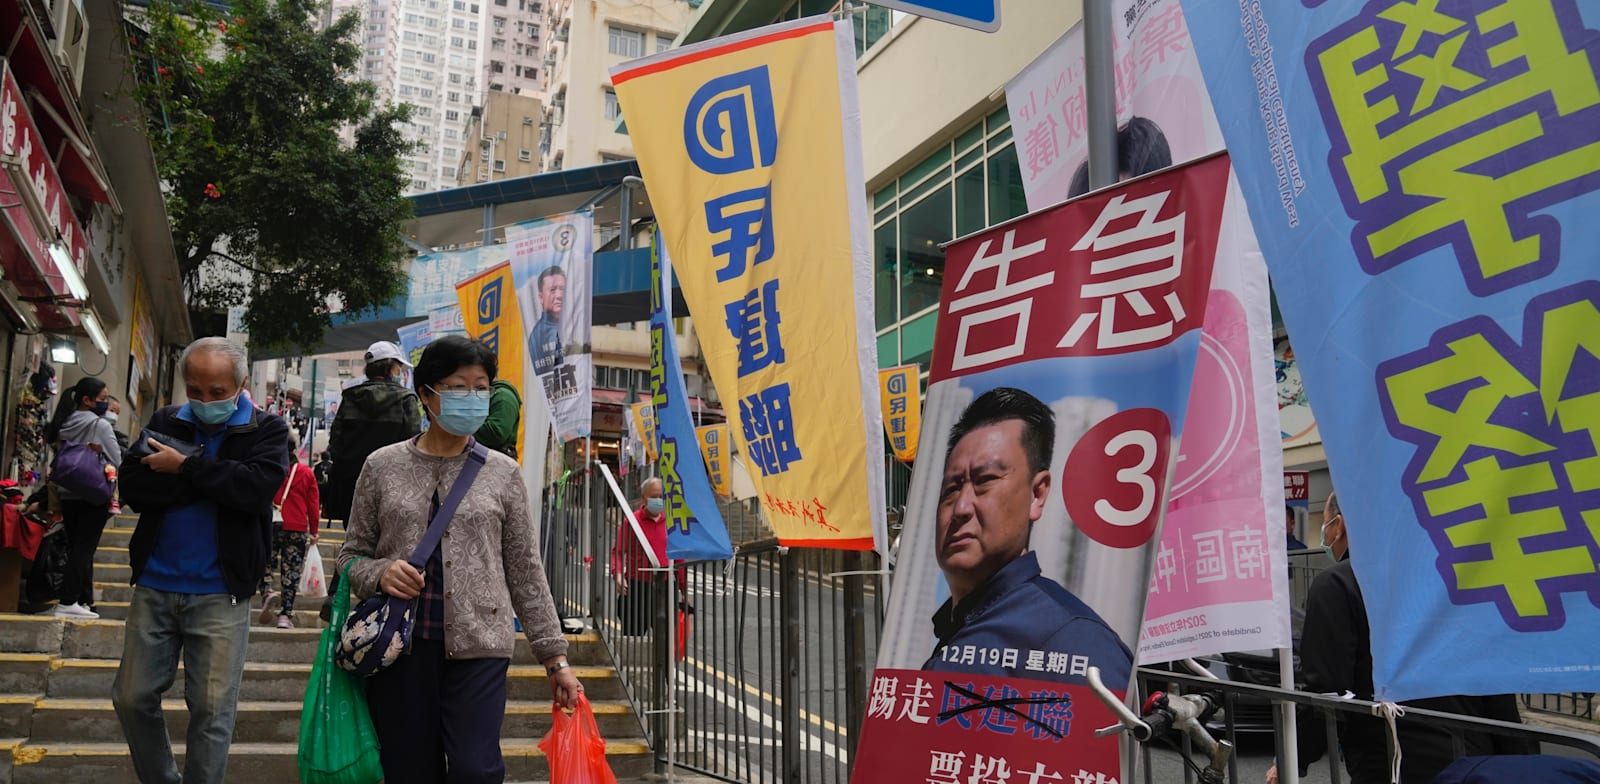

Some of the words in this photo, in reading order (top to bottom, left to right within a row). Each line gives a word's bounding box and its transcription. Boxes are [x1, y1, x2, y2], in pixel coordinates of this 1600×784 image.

[1094, 429, 1157, 527] 3
[940, 645, 1018, 669] 12月19日
[1025, 649, 1089, 677] 星期日
